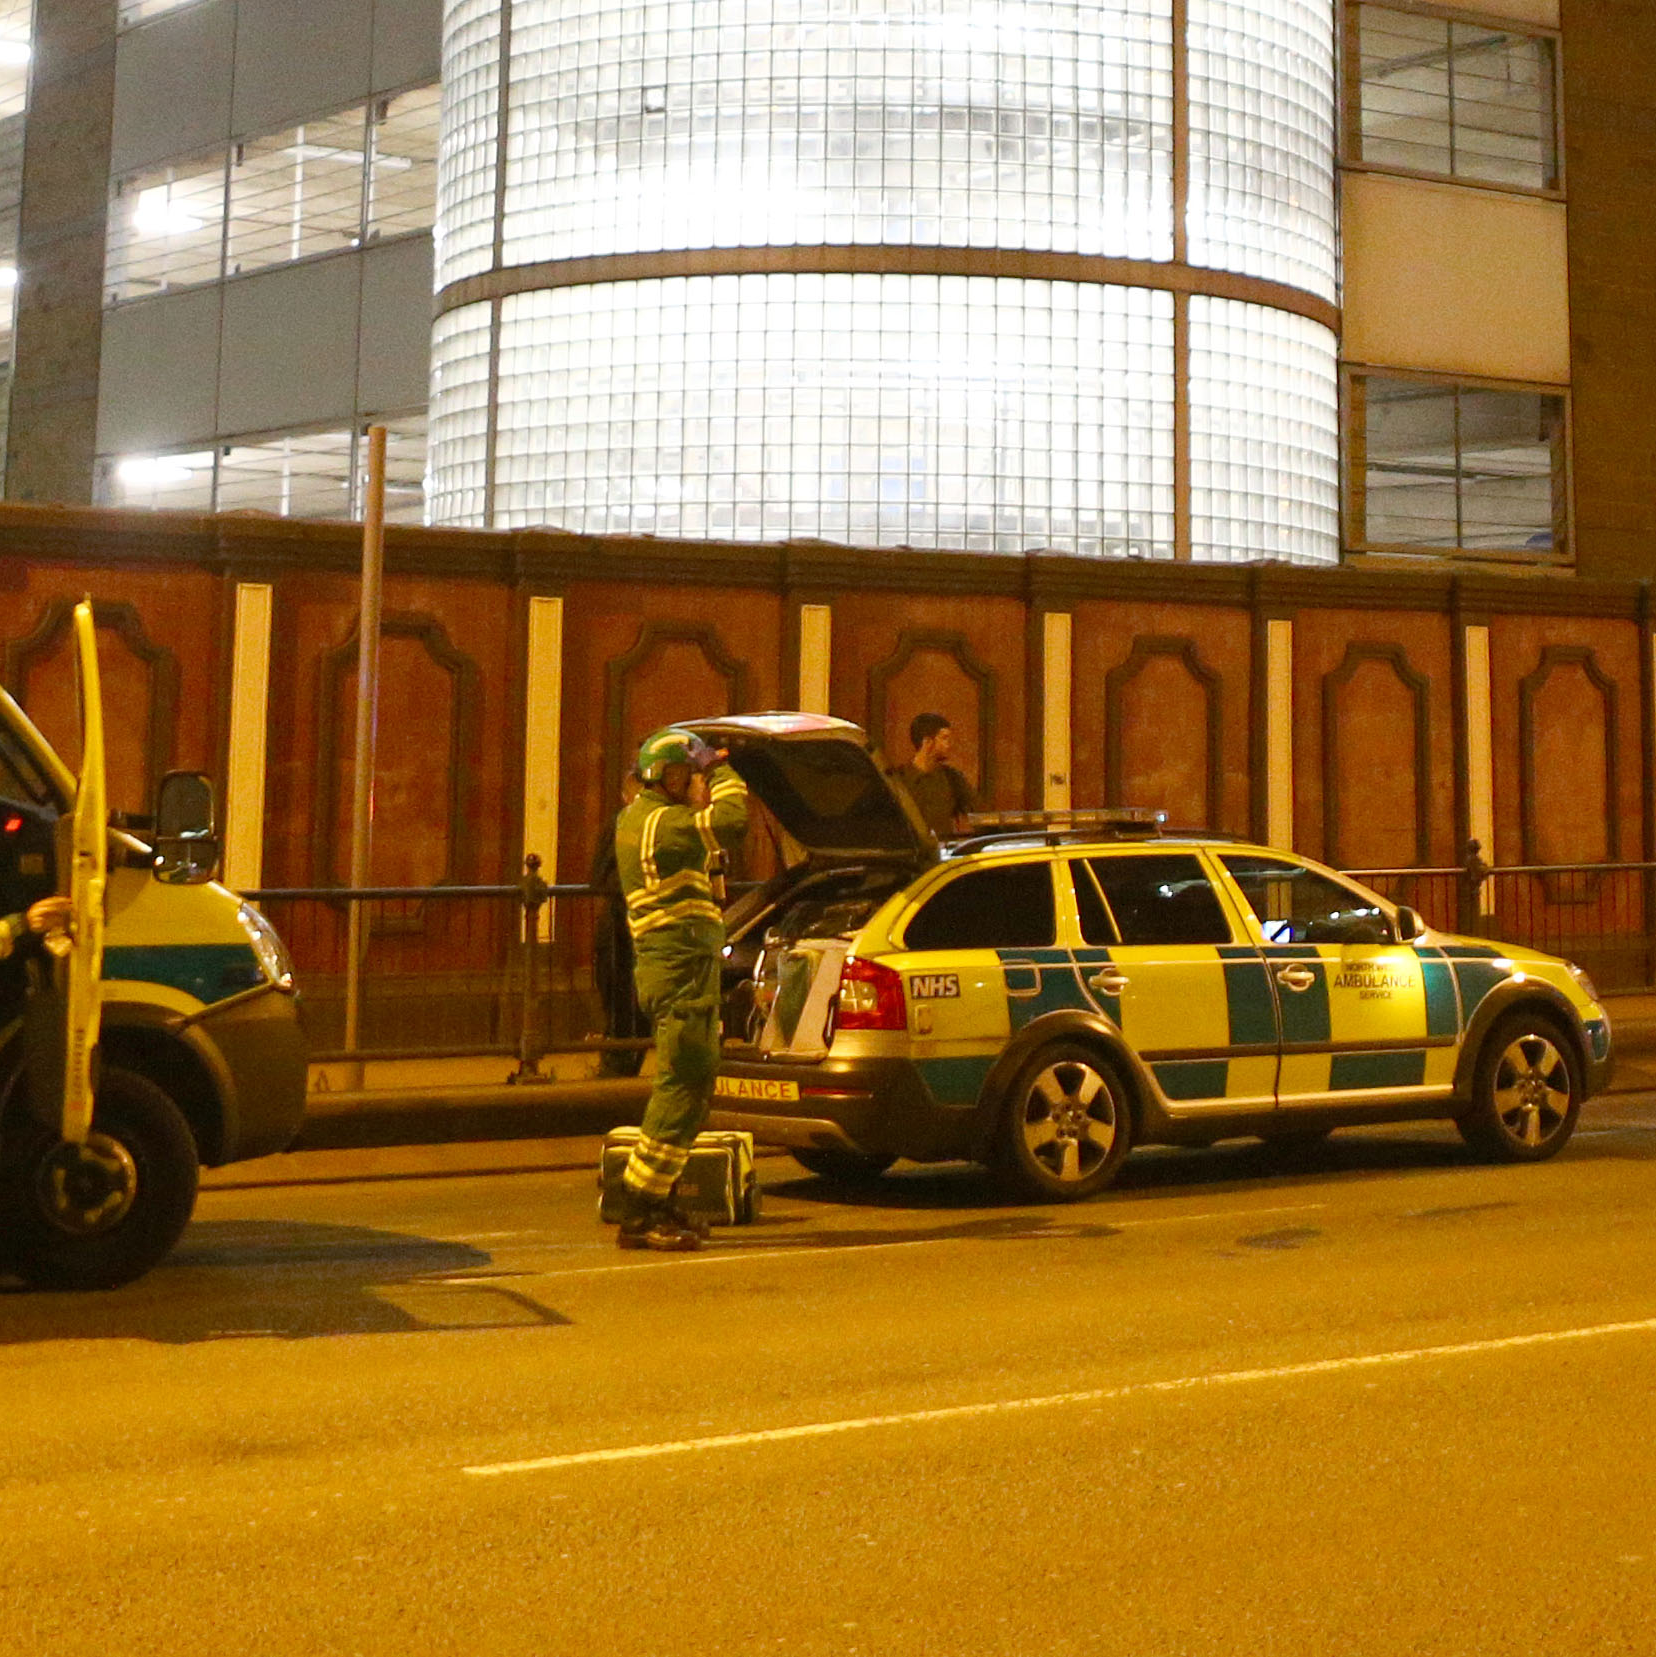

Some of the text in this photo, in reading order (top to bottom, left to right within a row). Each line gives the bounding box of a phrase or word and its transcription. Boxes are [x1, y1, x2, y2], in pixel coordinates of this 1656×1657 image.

[911, 975, 958, 997] NHS
[1334, 973, 1416, 989] AMBULANCE
[1359, 989, 1392, 1000] SERVICE
[714, 1078, 792, 1099] ULANCE
